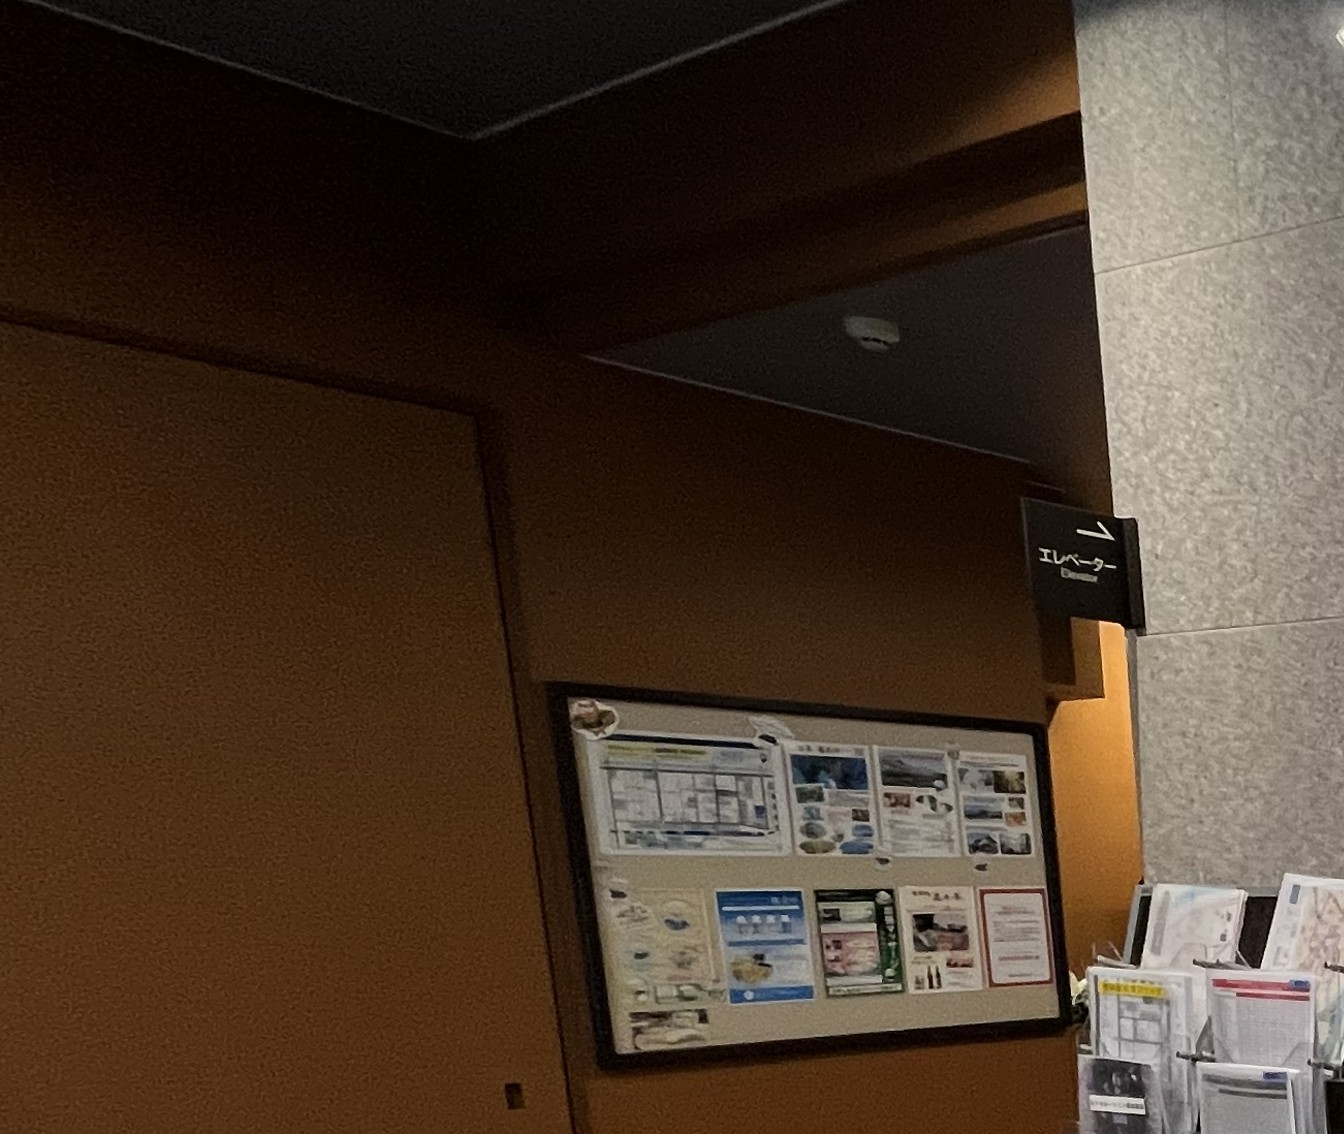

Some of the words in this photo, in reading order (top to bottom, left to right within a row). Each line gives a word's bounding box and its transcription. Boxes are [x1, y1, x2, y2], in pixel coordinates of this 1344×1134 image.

[1038, 547, 1117, 572] エレベーター
